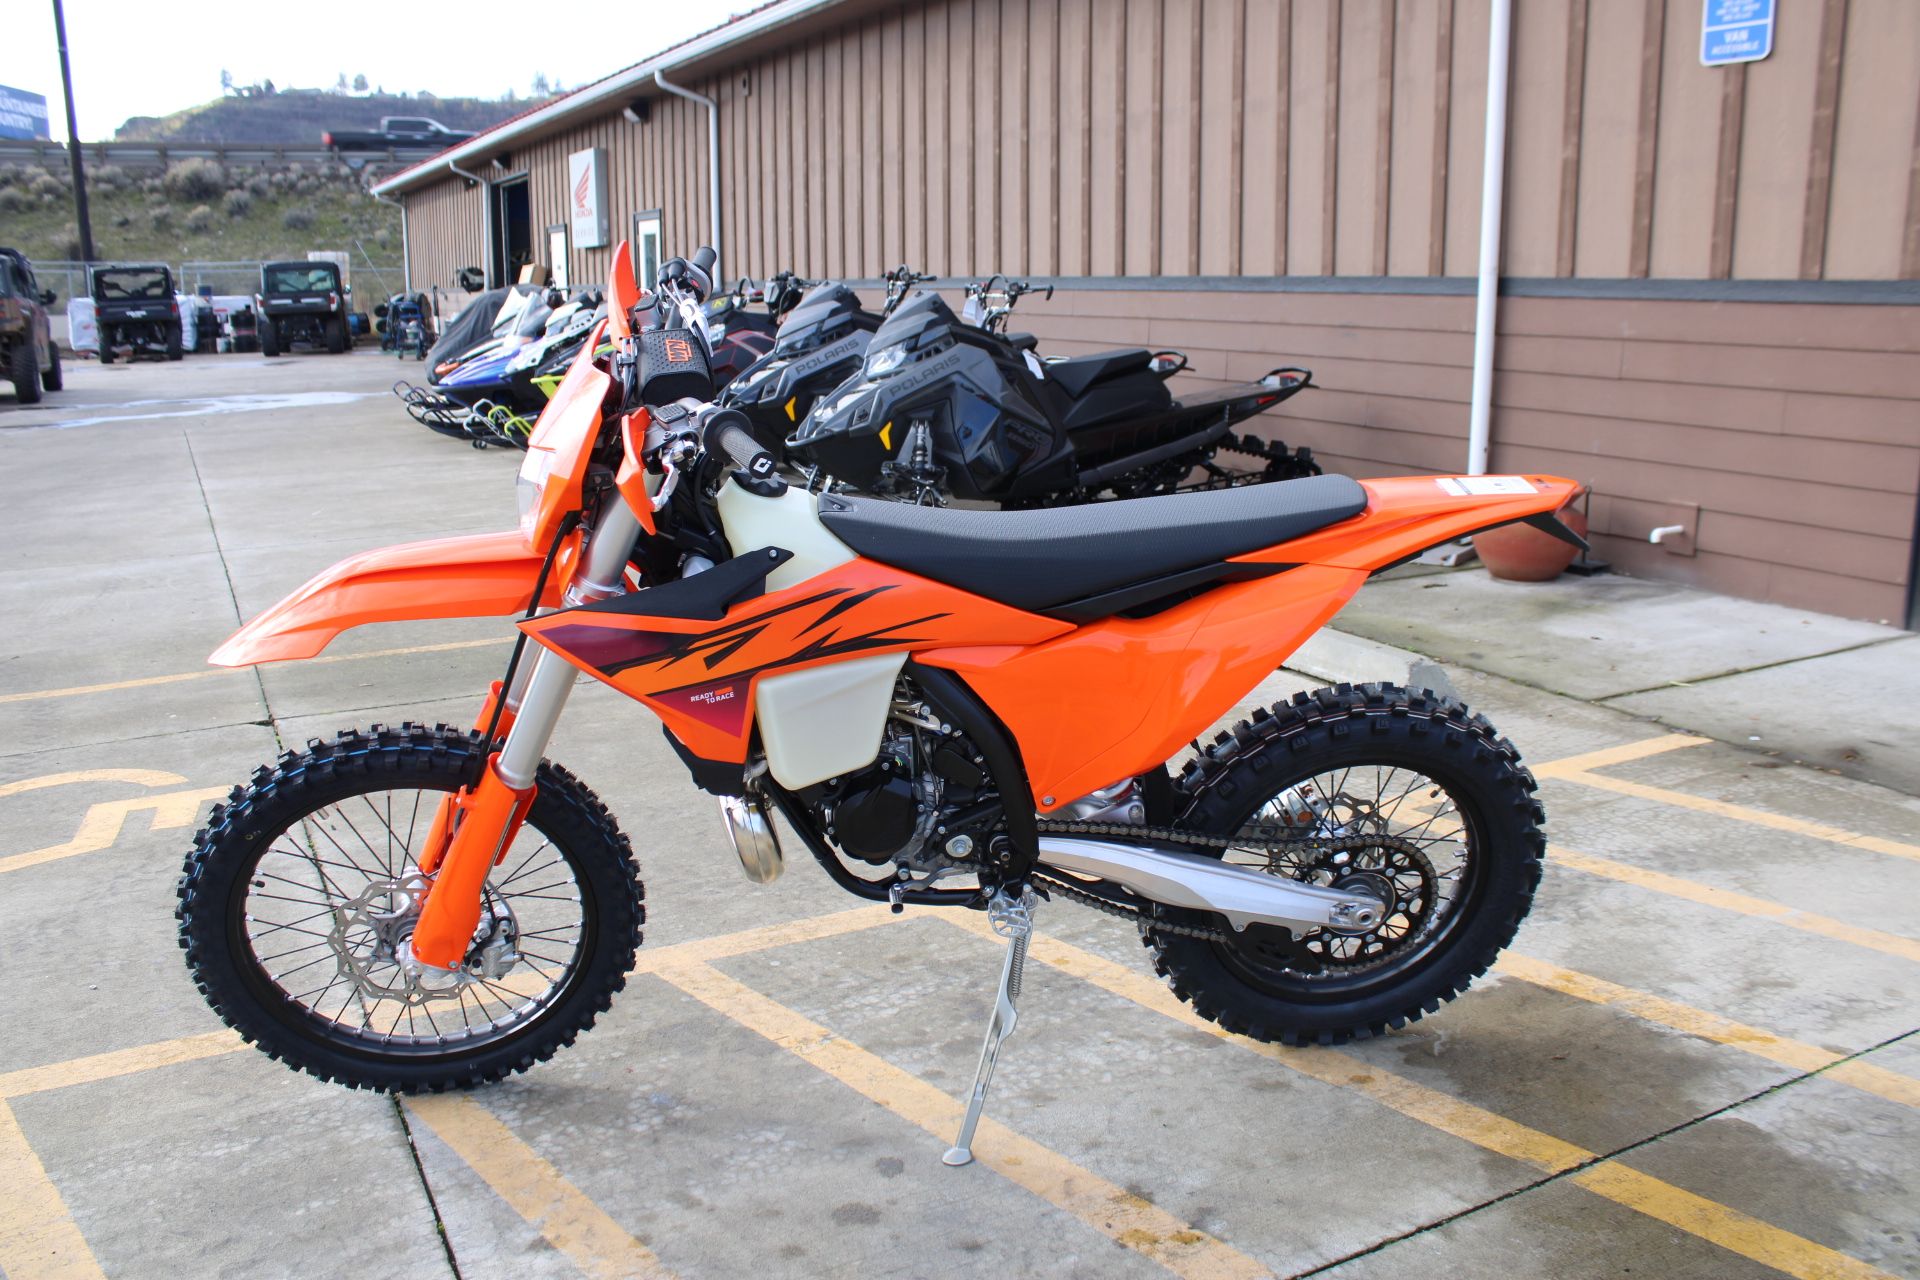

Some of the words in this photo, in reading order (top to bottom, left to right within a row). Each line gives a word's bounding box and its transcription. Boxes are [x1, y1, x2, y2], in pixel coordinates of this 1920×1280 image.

[1723, 28, 1750, 43] VAN
[795, 337, 860, 376] POLARIS
[889, 353, 961, 398] POLARIS
[690, 691, 714, 703] READY
[716, 691, 735, 702] RACE
